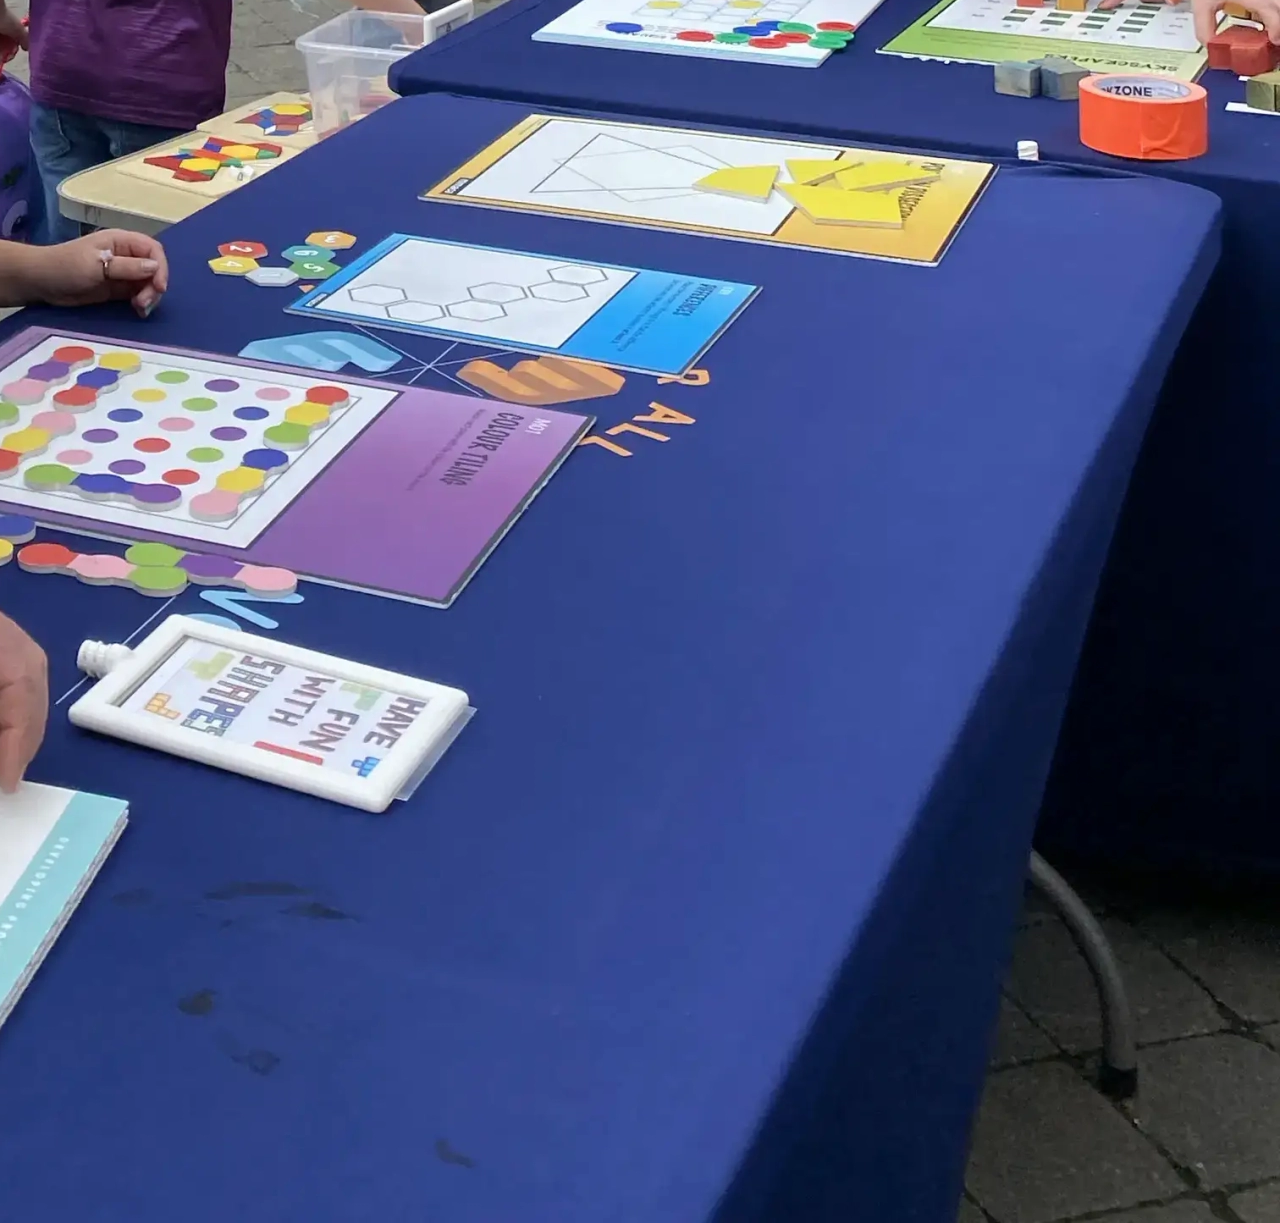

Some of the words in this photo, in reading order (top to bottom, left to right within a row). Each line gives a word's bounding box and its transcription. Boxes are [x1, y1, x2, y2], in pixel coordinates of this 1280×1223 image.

[229, 245, 253, 253] 2
[324, 235, 340, 244] 3
[303, 263, 325, 273] 5
[467, 412, 525, 452] COLOUR
[439, 451, 489, 486] TILING
[179, 654, 287, 739] SHAPES
[267, 675, 337, 728] WITH
[297, 707, 360, 753] FUN
[362, 696, 427, 750] HAVE
